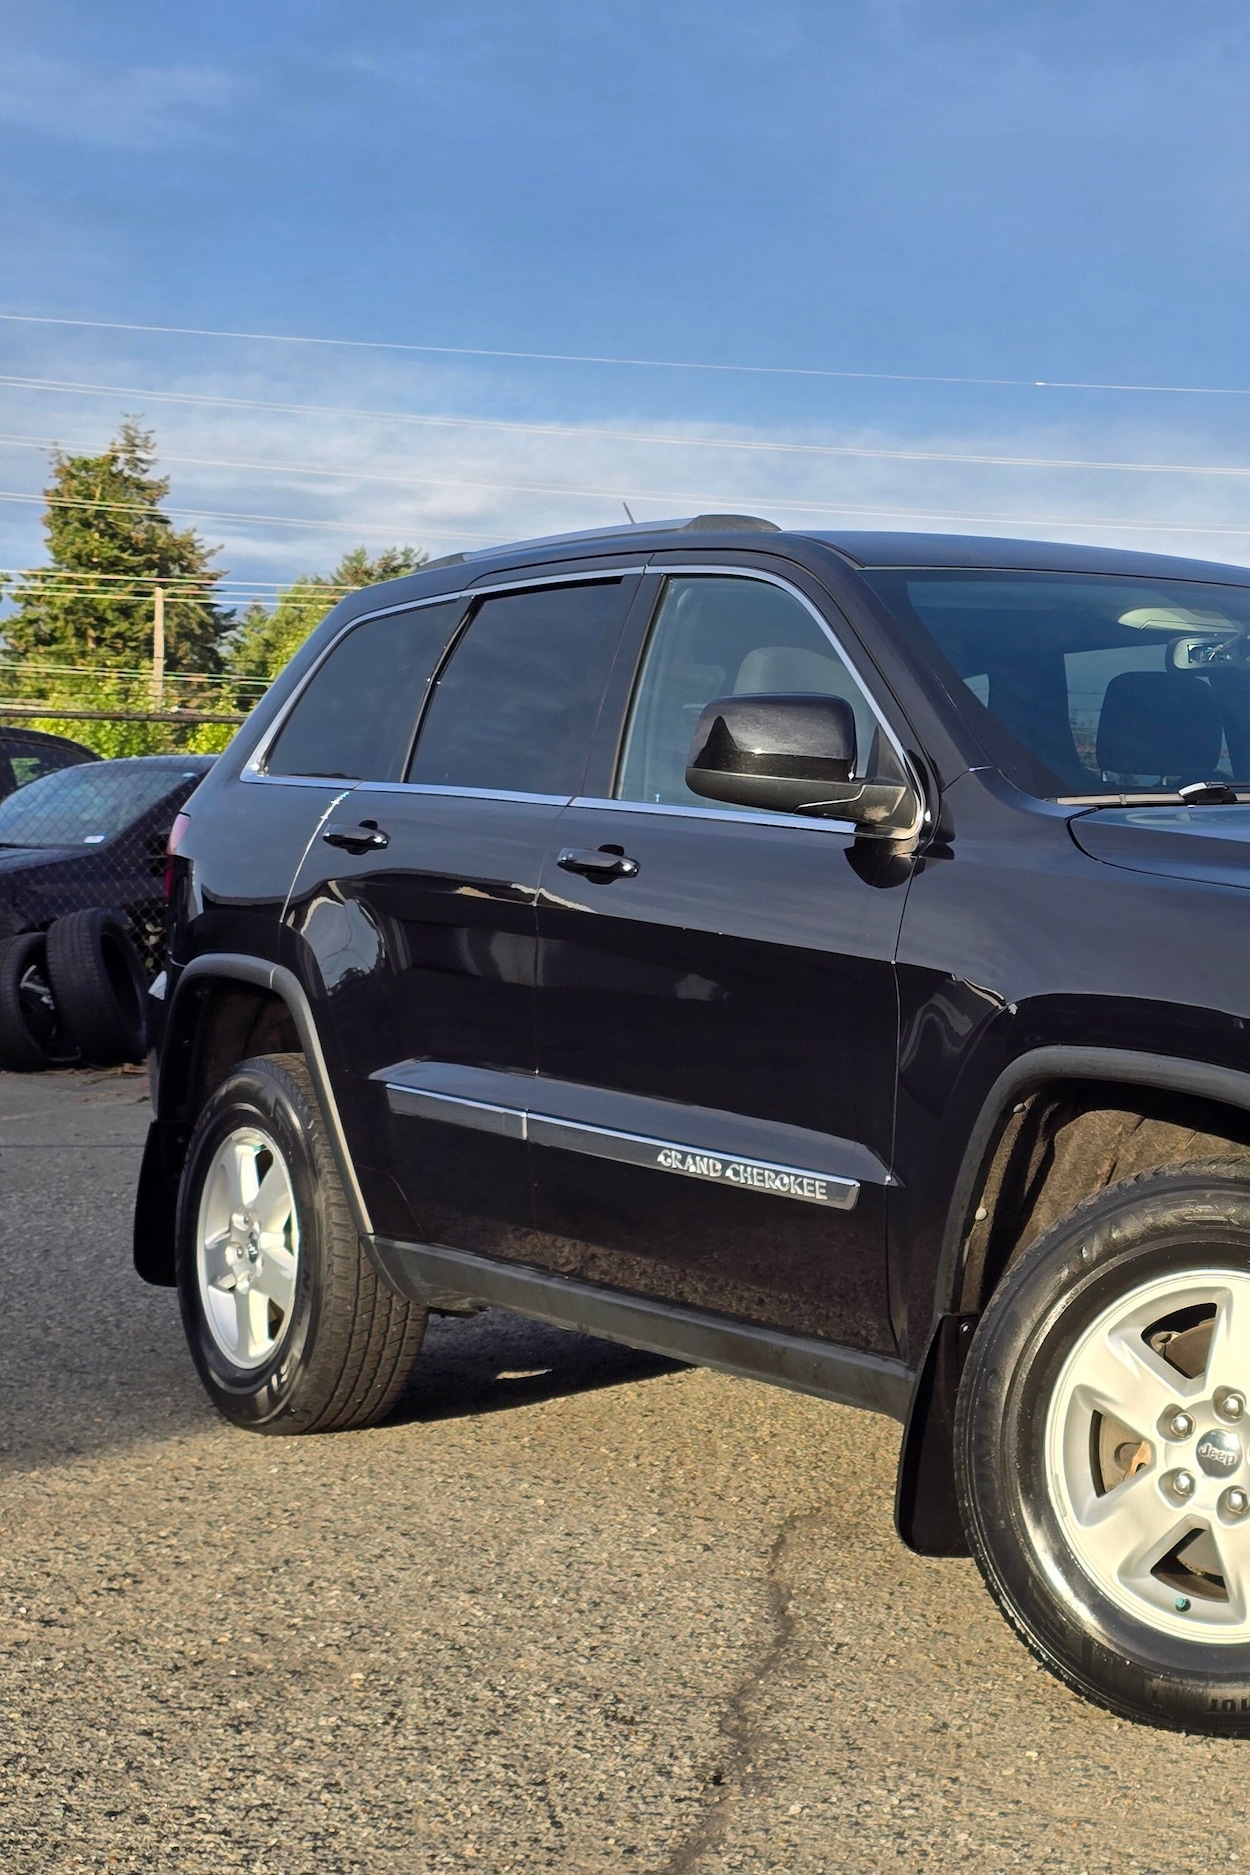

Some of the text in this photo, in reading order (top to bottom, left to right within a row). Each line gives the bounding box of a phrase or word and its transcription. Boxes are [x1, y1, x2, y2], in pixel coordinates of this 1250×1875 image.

[656, 1149, 828, 1200] GRAND CHEROKEE
[1199, 1442, 1237, 1466] Jeep
